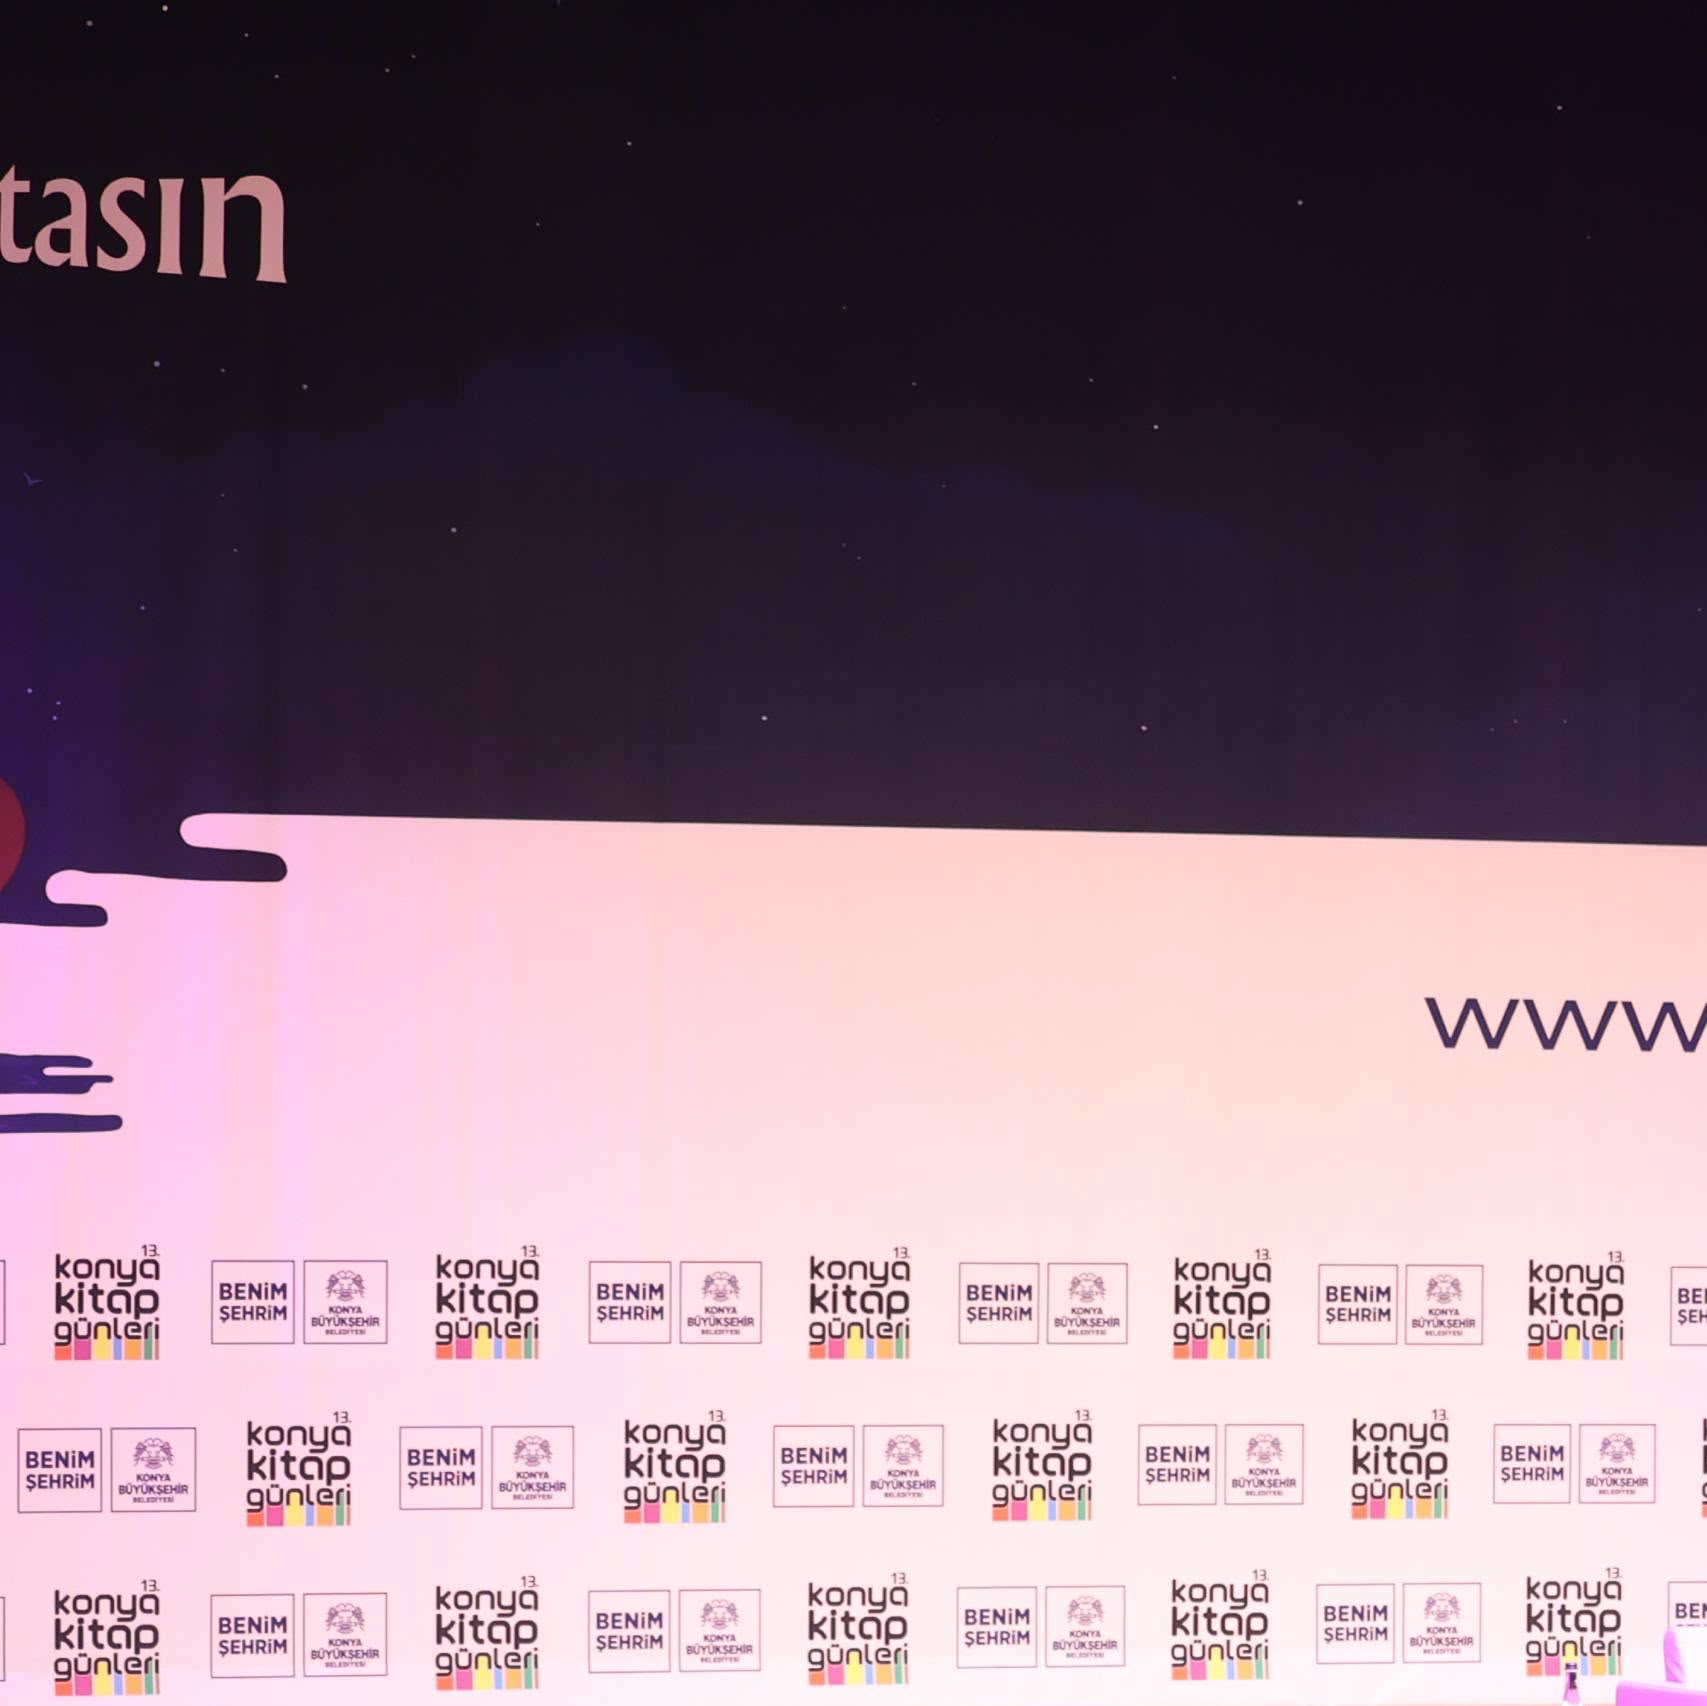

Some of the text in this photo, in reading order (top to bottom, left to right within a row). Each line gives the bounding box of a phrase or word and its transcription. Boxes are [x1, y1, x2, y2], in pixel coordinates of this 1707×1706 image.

[0, 163, 288, 284] tasın
[55, 1253, 159, 1287] konya
[436, 1254, 539, 1288] konya
[810, 1256, 909, 1289] konya
[1174, 1257, 1271, 1291] konya
[55, 1281, 159, 1320] kitap
[328, 1305, 363, 1315] KONYA
[436, 1282, 539, 1321] kitap
[703, 1305, 738, 1314] KONYA
[810, 1283, 909, 1322] kitap
[1071, 1306, 1104, 1315] KONYA
[1174, 1285, 1271, 1322] kitap
[54, 1317, 159, 1347] günleri
[435, 1317, 539, 1347] günleri
[809, 1318, 909, 1348] günleri
[1173, 1318, 1271, 1348] günleri
[247, 1420, 351, 1454] konya
[625, 1419, 725, 1453] konya
[1352, 1417, 1448, 1451] konya
[136, 1474, 172, 1483] KONYA
[247, 1448, 351, 1487] kitap
[515, 1470, 549, 1480] KONYA
[625, 1447, 725, 1485] kitap
[1248, 1467, 1281, 1476] KONYA
[1352, 1445, 1448, 1482] kitap
[246, 1484, 351, 1514] günleri
[624, 1481, 725, 1511] günleri
[1351, 1478, 1448, 1508] günleri
[55, 1588, 159, 1623] konya
[808, 1581, 907, 1615] konya
[55, 1617, 159, 1656] kitap
[328, 1639, 363, 1648] KONYA
[808, 1609, 907, 1647] kitap
[1068, 1629, 1101, 1638] KONYA
[54, 1652, 159, 1683] günleri
[807, 1643, 907, 1673] günleri
